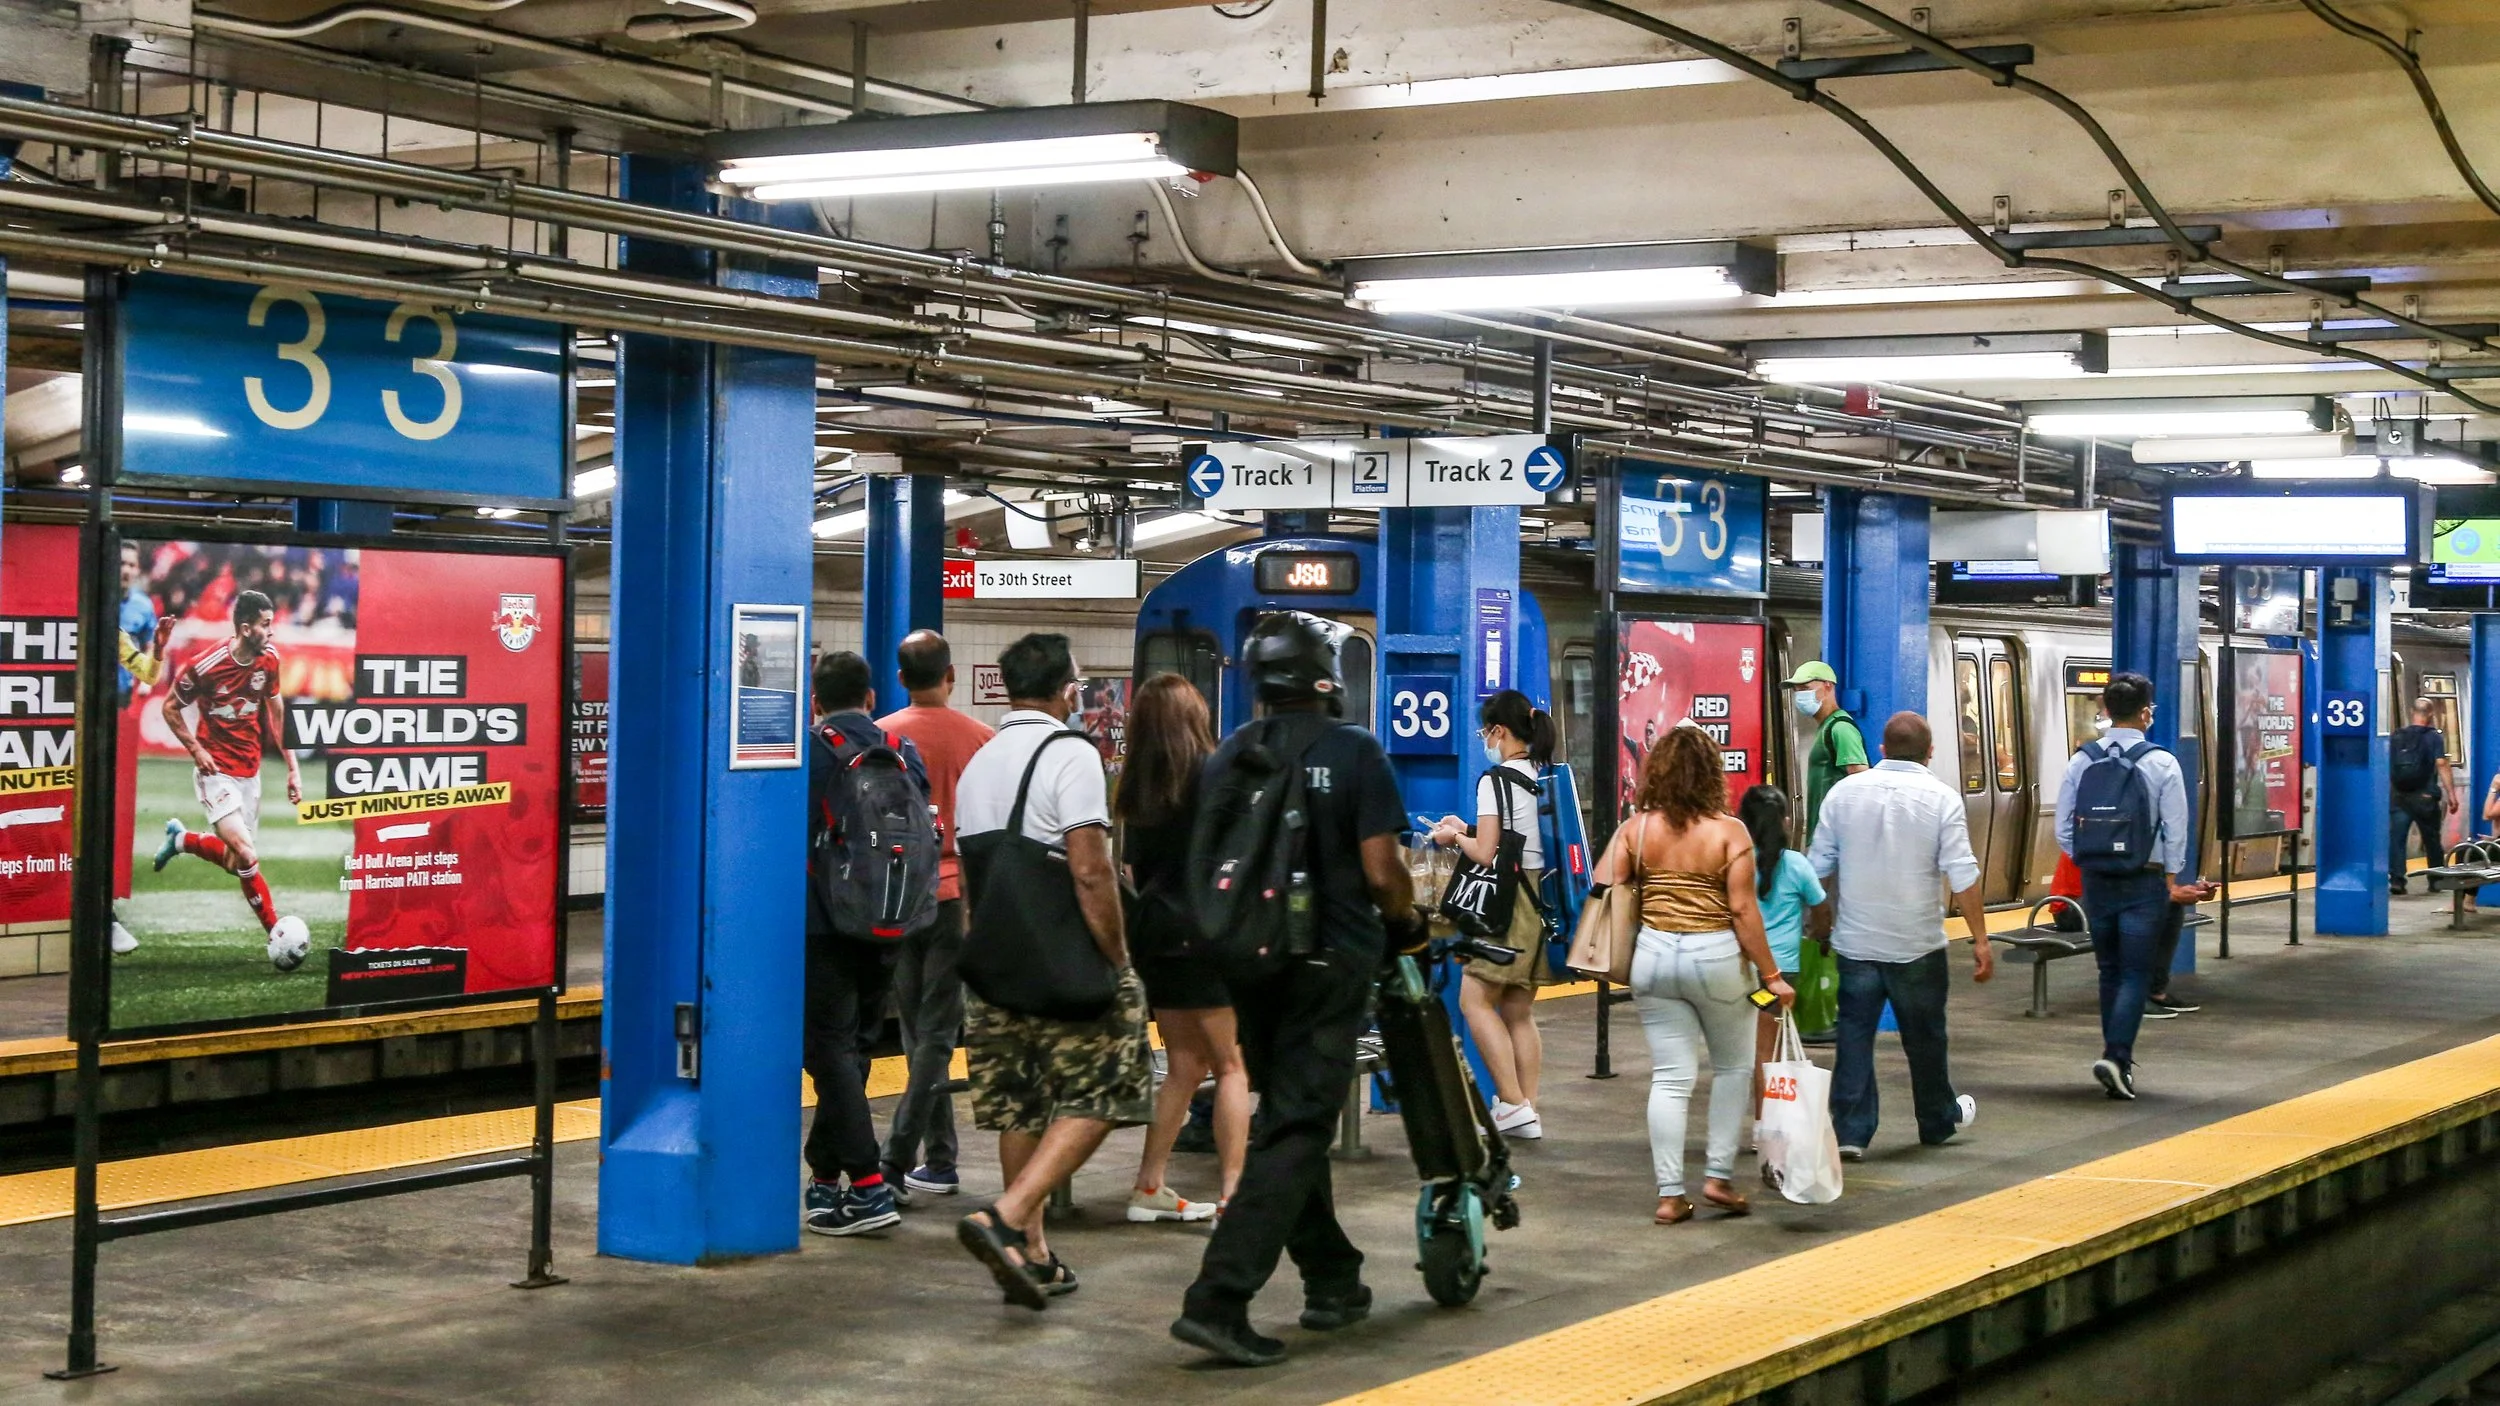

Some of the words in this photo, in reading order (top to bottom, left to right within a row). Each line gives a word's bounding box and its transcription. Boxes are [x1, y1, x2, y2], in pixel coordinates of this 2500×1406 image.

[1231, 462, 1294, 486] Track
[1303, 463, 1313, 485] 1
[1362, 456, 1378, 482] 2
[1425, 458, 1491, 483] Track
[1500, 458, 1514, 481] 2
[1354, 483, 1386, 493] Platform
[980, 573, 995, 587] To
[999, 572, 1028, 587] 30th
[1032, 572, 1073, 587] Street
[1288, 562, 1328, 586] JSQ
[363, 659, 458, 695] THE
[1392, 690, 1450, 738] 33
[1694, 697, 1729, 717] RED
[2268, 696, 2285, 711] THE
[2326, 699, 2365, 727] 33
[292, 708, 518, 745] WORLD'S
[1701, 724, 1729, 745] OT
[1721, 751, 1747, 771] ER
[334, 756, 479, 794] GAME
[302, 801, 358, 821] JUST
[361, 792, 450, 815] MINUTES
[453, 786, 506, 804] AWAY
[26, 855, 56, 873] from
[344, 855, 363, 870] Red
[365, 852, 384, 869] Bull
[385, 853, 413, 868] Arena
[414, 851, 433, 870] just
[433, 851, 459, 869] steps
[339, 875, 363, 891] from
[365, 873, 405, 890] Harrison
[406, 871, 430, 887] PATH
[431, 869, 463, 886] station
[1447, 873, 1498, 916] MET
[367, 960, 392, 970] TICKETS
[402, 959, 418, 967] SALE
